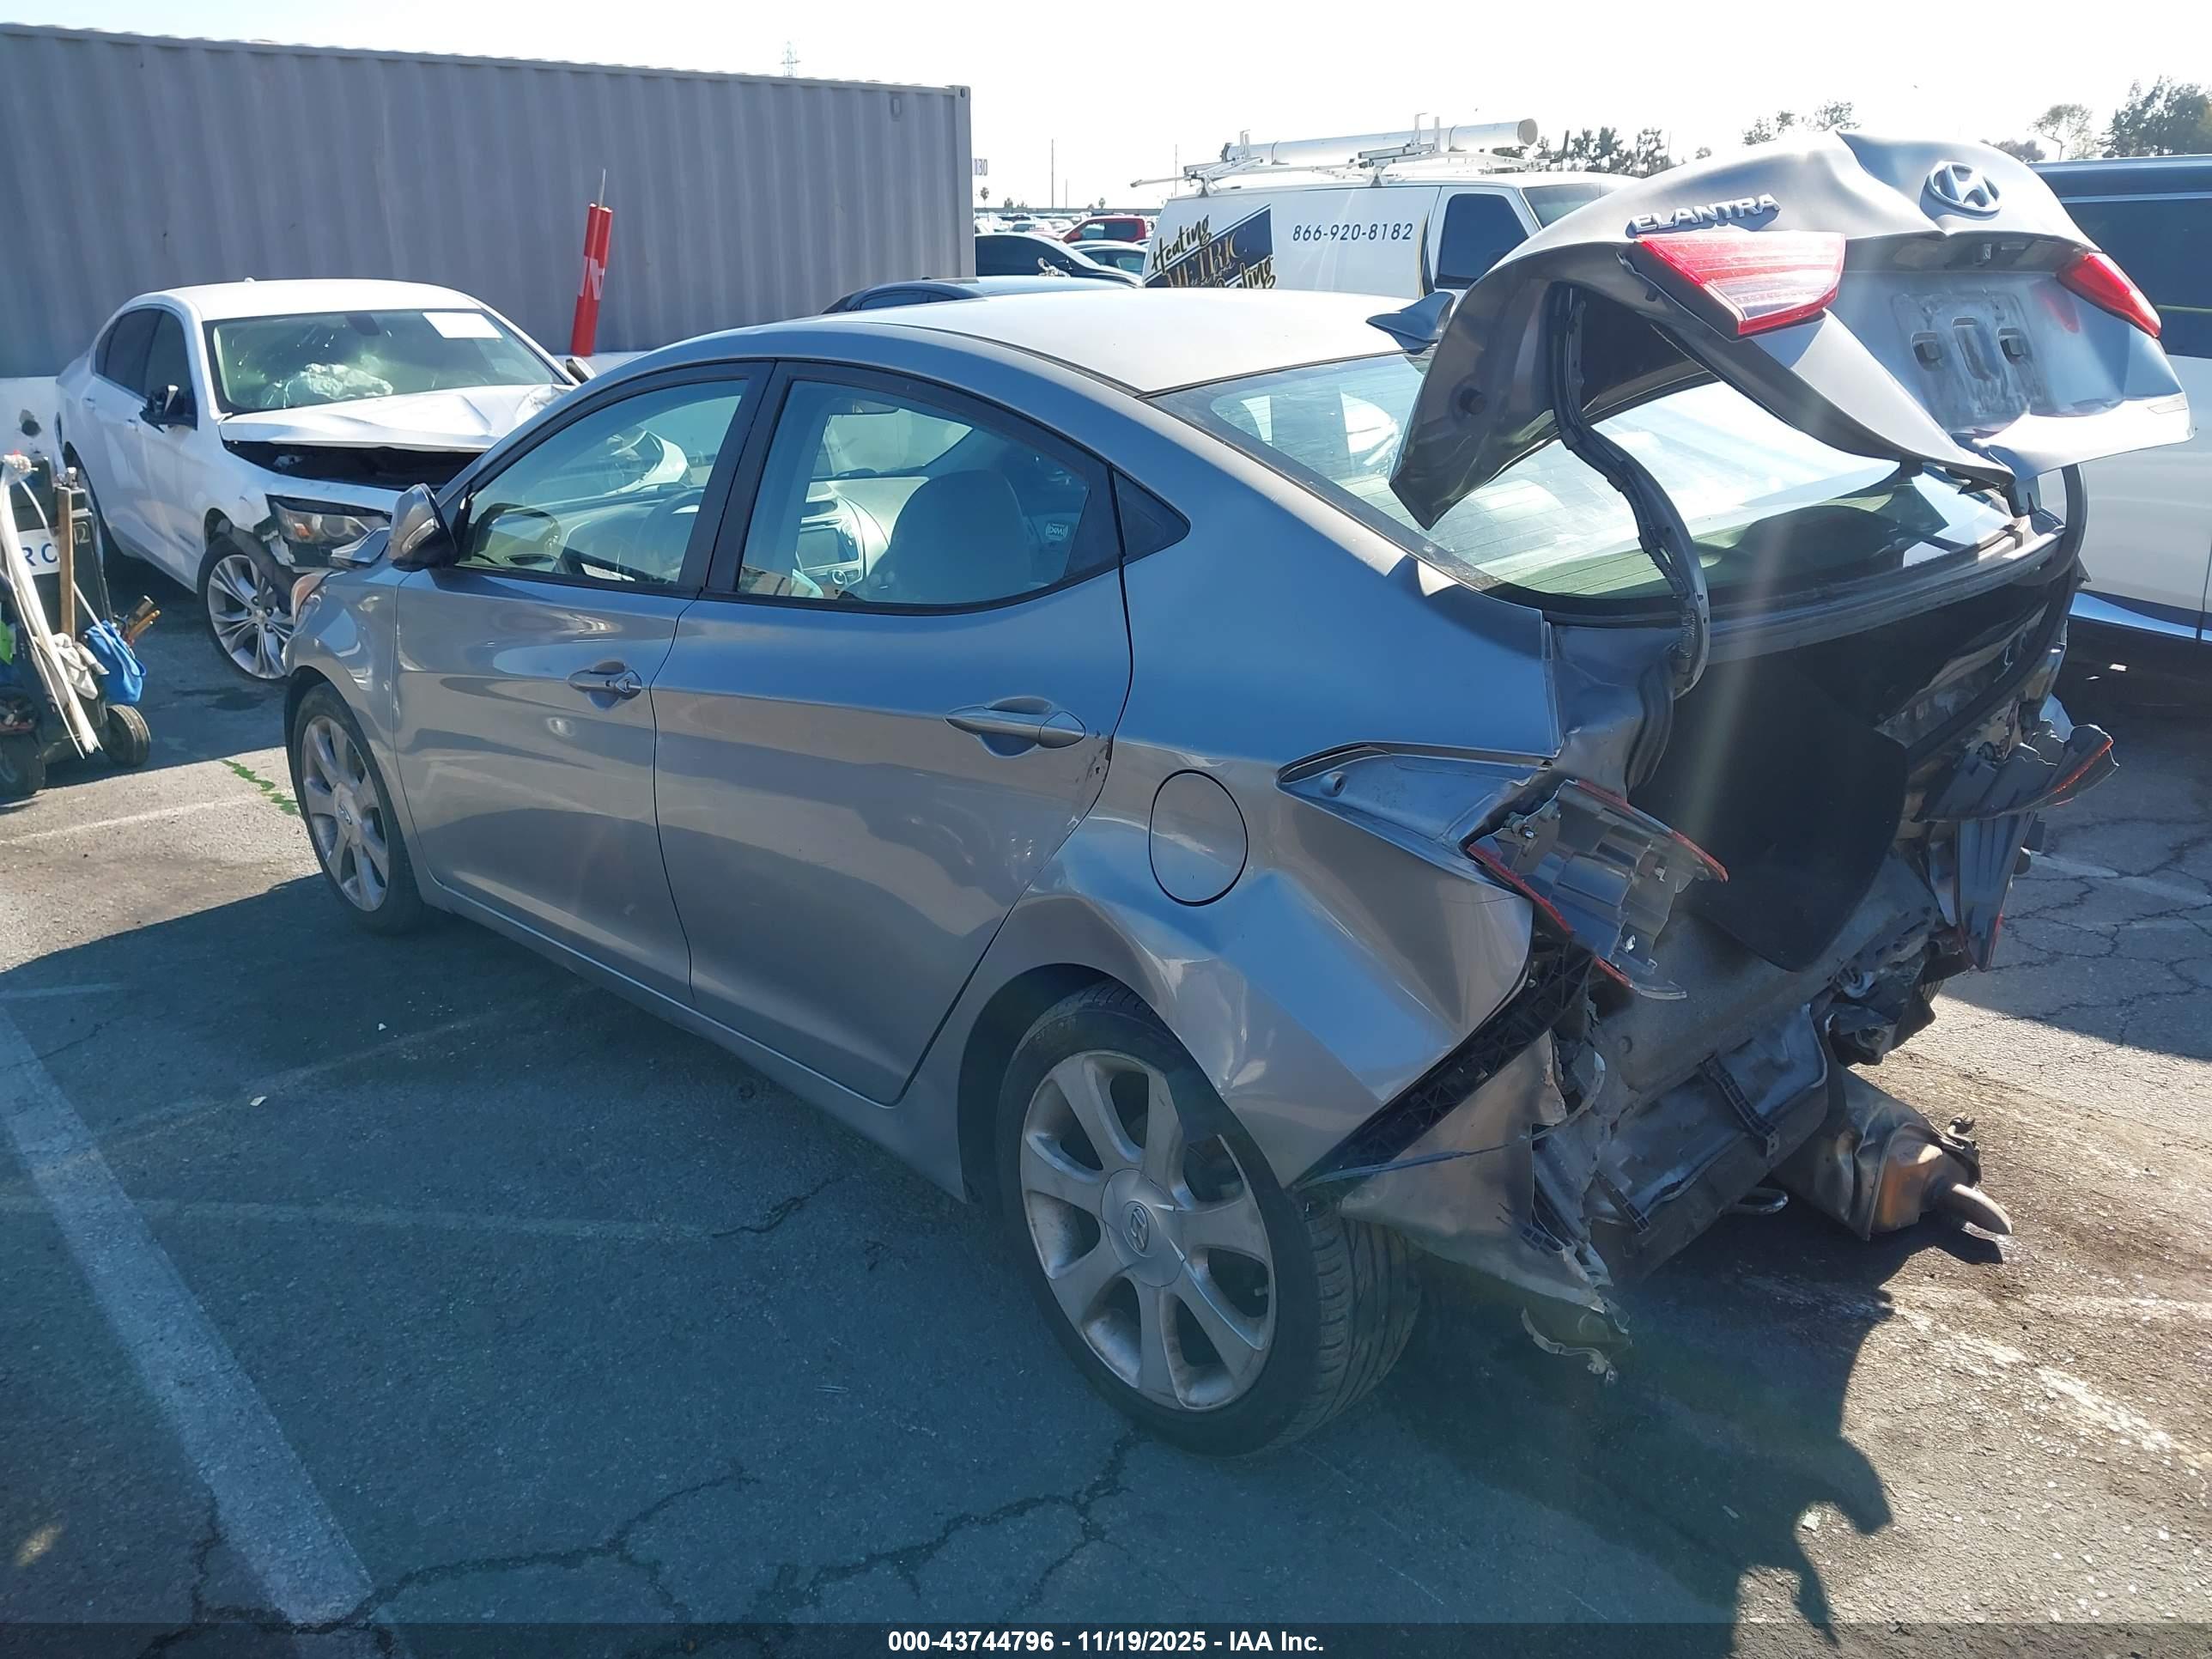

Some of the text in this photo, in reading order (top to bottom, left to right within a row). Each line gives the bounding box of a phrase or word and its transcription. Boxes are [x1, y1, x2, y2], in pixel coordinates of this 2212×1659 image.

[1292, 222, 1413, 242] 866-920-8182
[1631, 193, 1781, 233] ELANTRA
[1151, 214, 1212, 275] Heating
